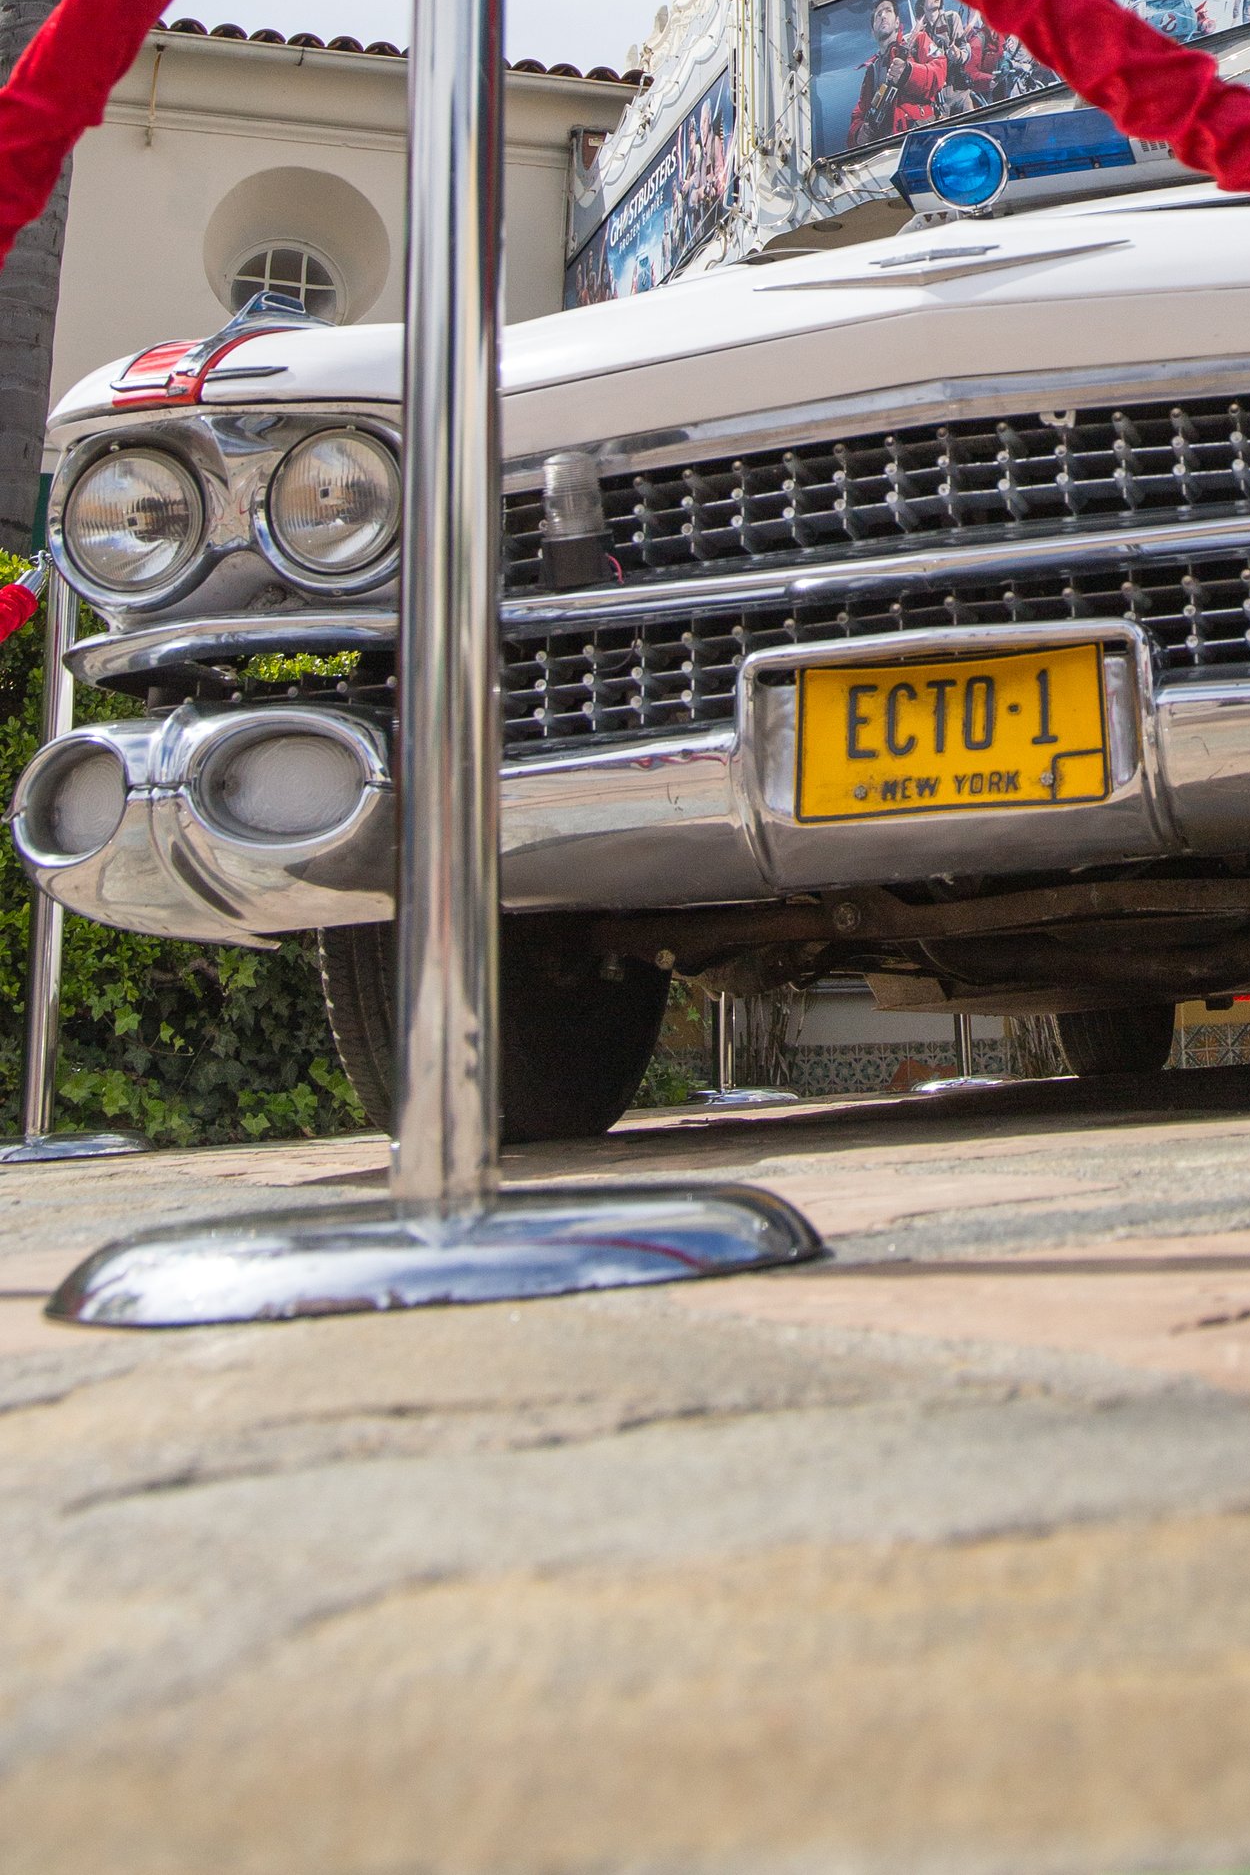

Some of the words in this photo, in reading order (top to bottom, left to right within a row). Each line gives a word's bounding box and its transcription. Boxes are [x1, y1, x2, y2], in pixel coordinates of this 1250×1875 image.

[618, 220, 641, 254] FROZEN
[881, 775, 941, 801] NEW
[954, 770, 1021, 796] YORK
